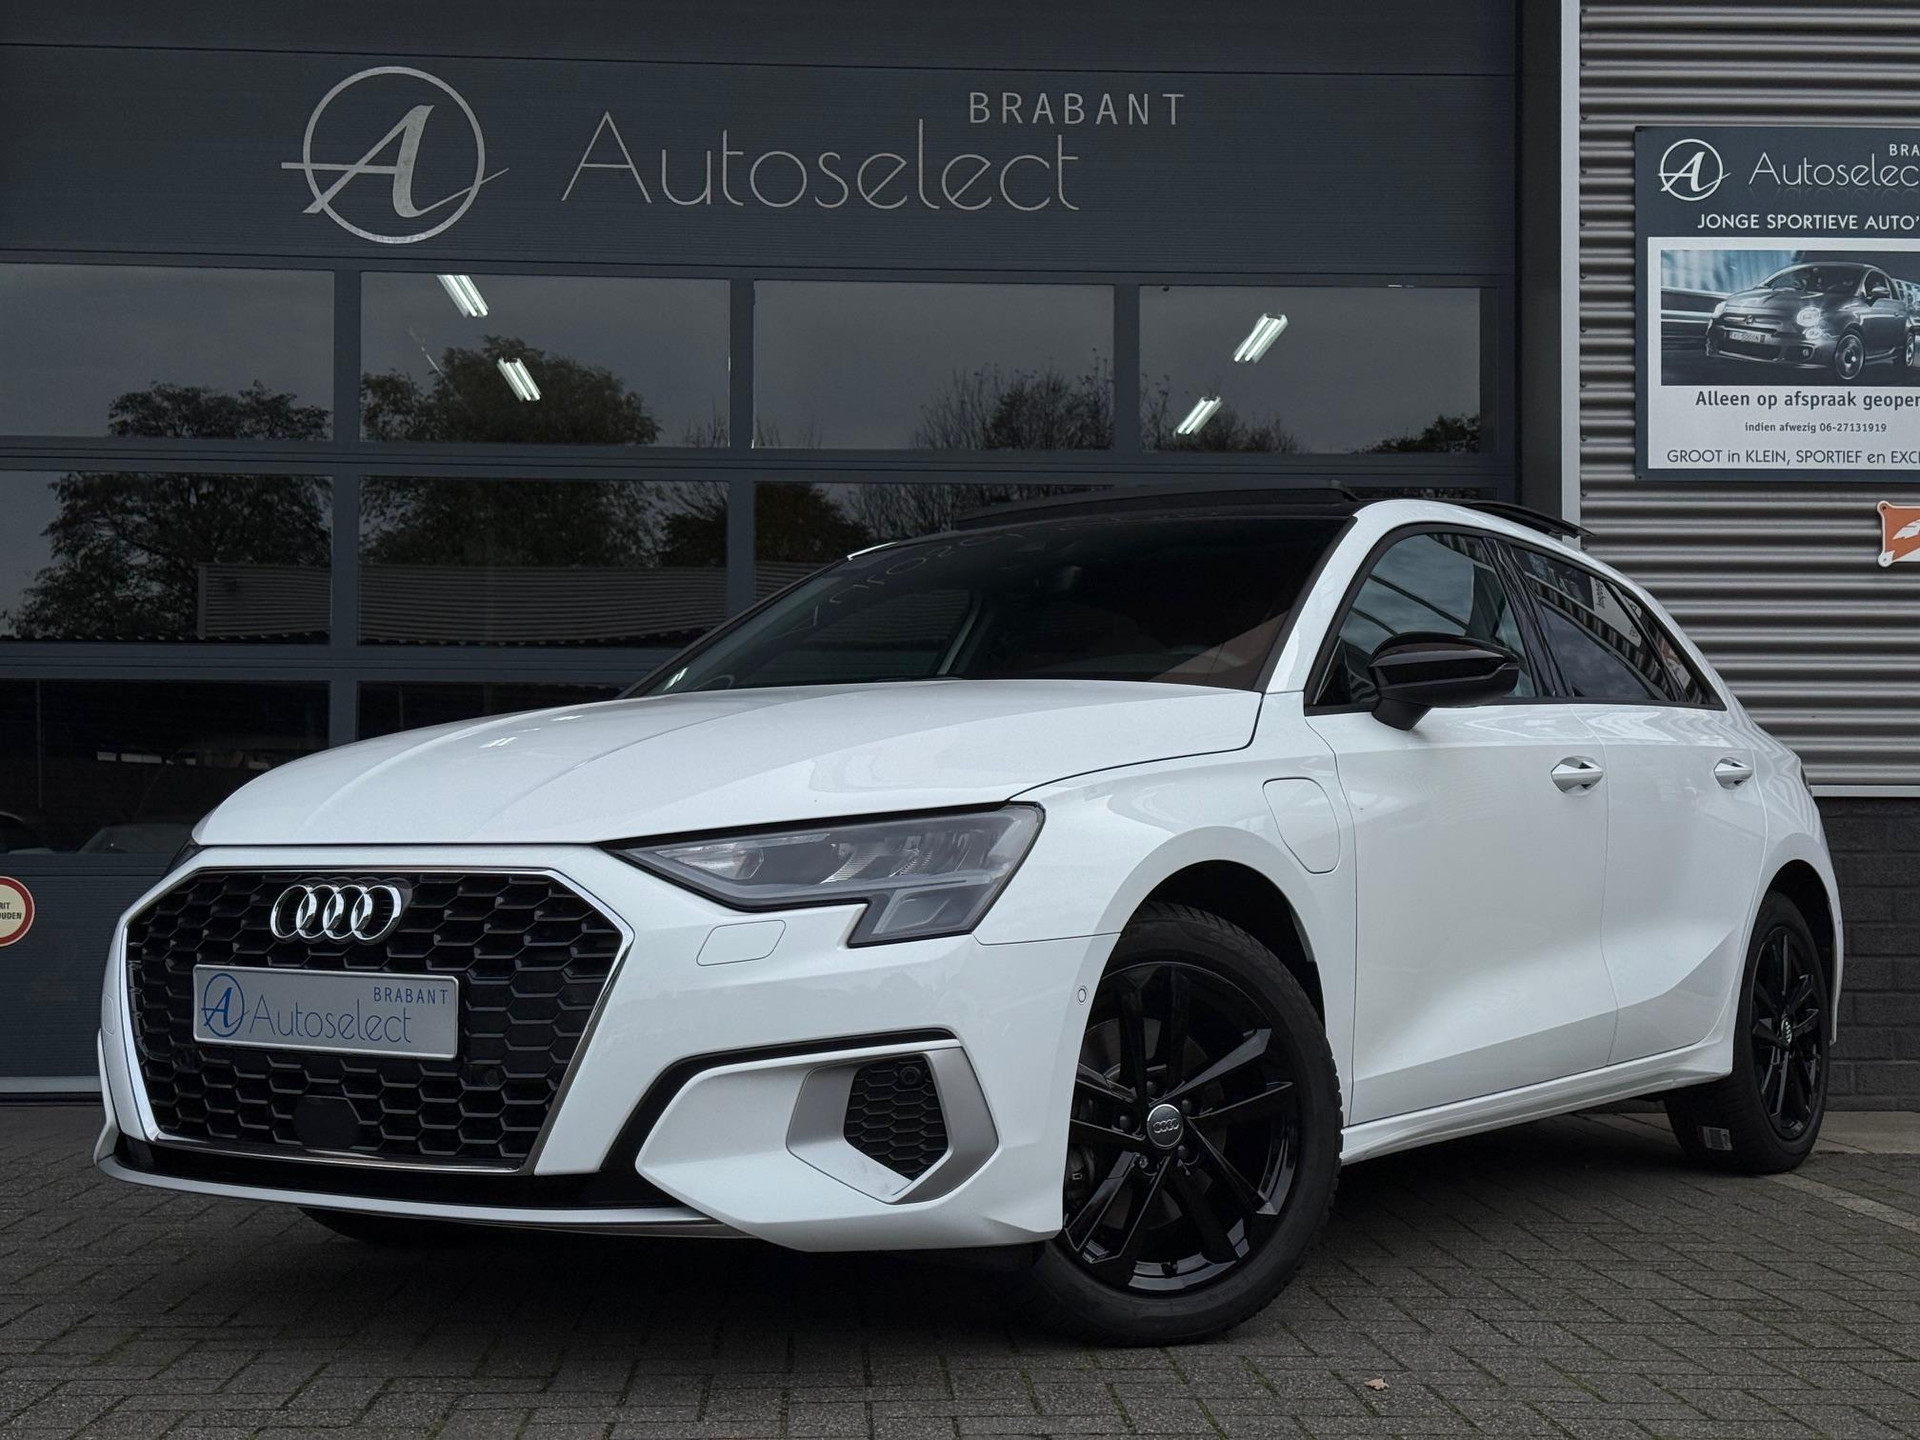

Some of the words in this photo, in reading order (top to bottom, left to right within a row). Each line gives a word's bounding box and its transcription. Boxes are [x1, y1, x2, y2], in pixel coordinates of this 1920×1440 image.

[968, 91, 1186, 126] BRABANT
[562, 111, 1079, 211] Autoselect
[1697, 213, 1760, 229] JONGE
[1767, 213, 1859, 230] SPORTIEVE
[1695, 390, 1750, 407] Alleen
[1757, 394, 1778, 410] op
[1784, 390, 1857, 410] afspraak
[1744, 421, 1776, 432] indien
[1779, 421, 1817, 434] afwezig
[1819, 422, 1887, 433] 06-27131919
[1667, 449, 1723, 464] GROOT
[1727, 450, 1741, 463] in
[1746, 449, 1791, 466] KLEIN,
[1796, 449, 1863, 464] SPORTIEF
[1866, 453, 1886, 464] en
[373, 986, 449, 1005] BRABANT
[248, 993, 413, 1044] Autoselect
